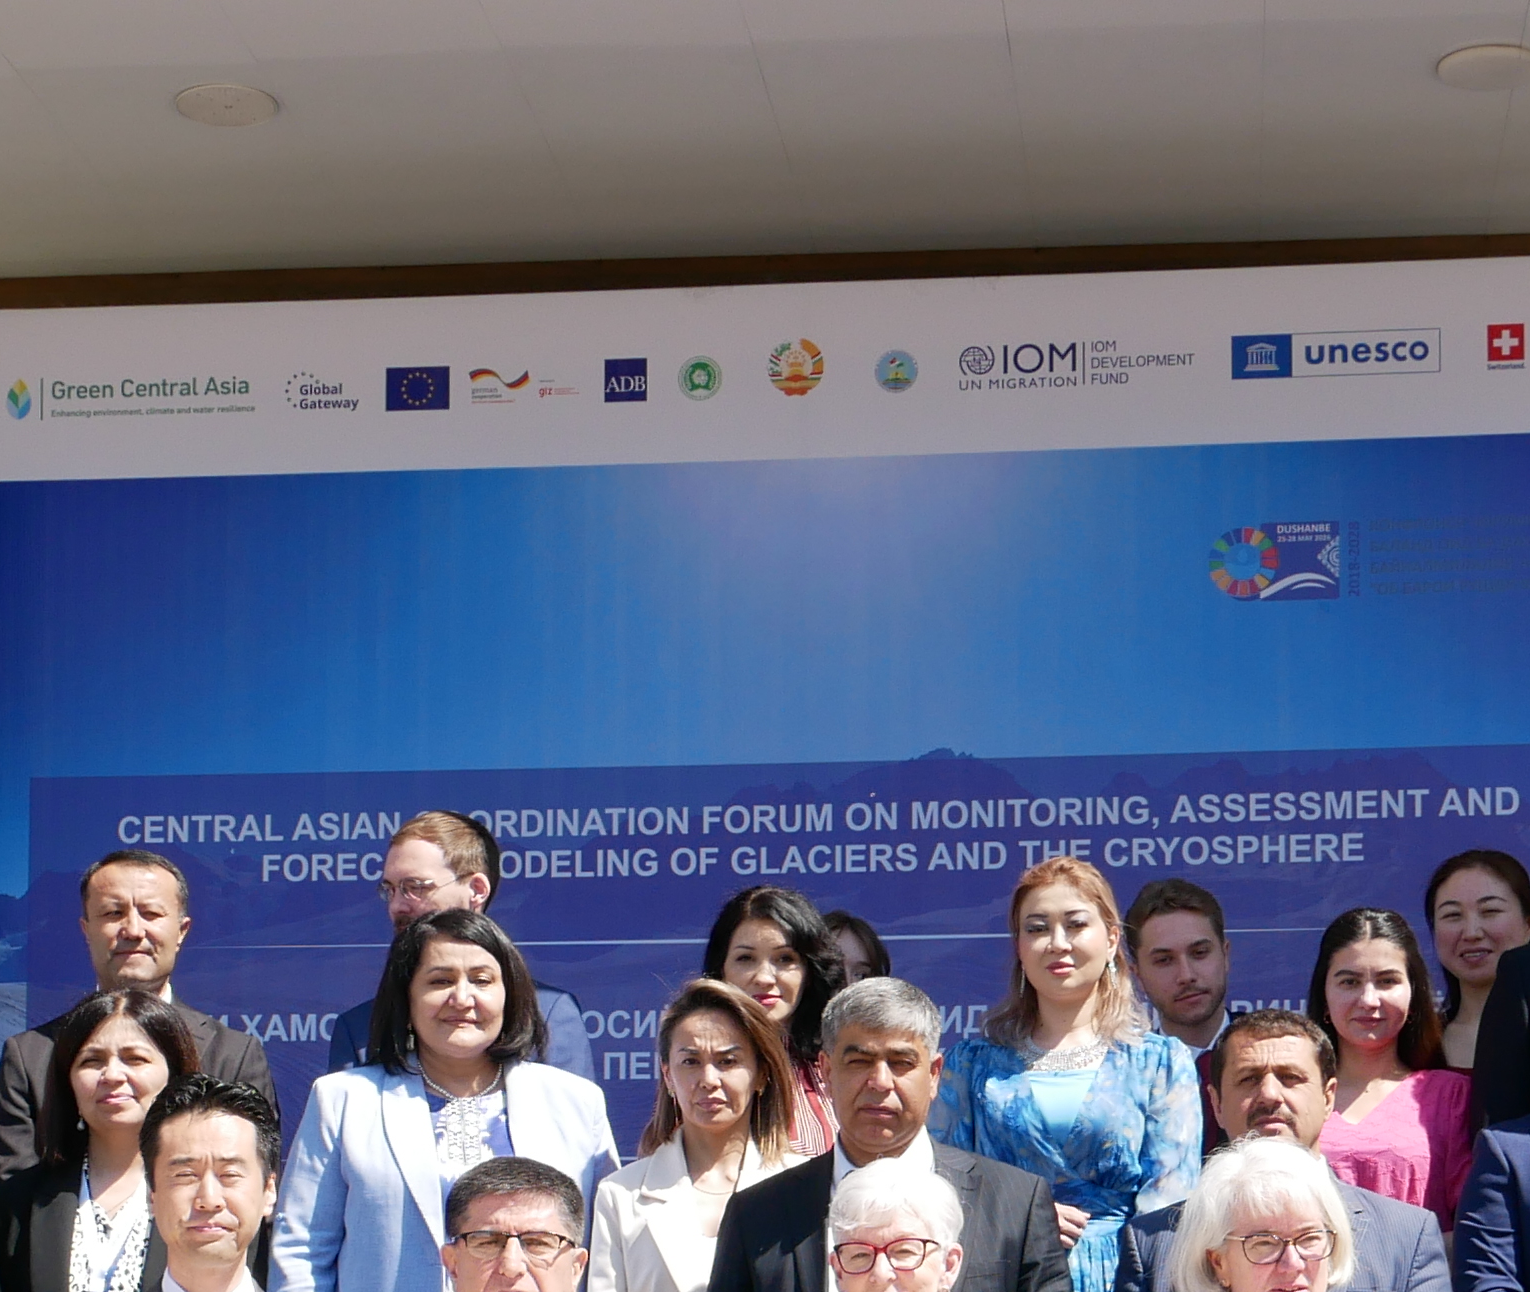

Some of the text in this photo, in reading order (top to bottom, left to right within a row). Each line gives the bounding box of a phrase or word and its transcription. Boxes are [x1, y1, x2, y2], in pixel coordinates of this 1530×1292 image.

[1090, 340, 1117, 353] IOM
[1304, 340, 1430, 365] unesco
[1002, 341, 1078, 375] IOM
[1090, 353, 1195, 369] DEVELOPMENT
[605, 375, 646, 393] ADB
[959, 376, 1078, 391] UN MIGRATION
[1090, 372, 1130, 386] FUND
[51, 376, 250, 400] Green Central Asia
[299, 382, 343, 396] Global
[50, 404, 256, 419] Enhancing environment, climate and water resilience
[299, 398, 359, 412] Gateway
[1276, 523, 1331, 534] DUSHANBE
[118, 814, 284, 844] CENTRAL
[291, 811, 401, 841] ASIAN
[702, 803, 833, 834] FORUM
[845, 801, 898, 832] ON
[911, 795, 1160, 831] MONITORING,
[1169, 788, 1431, 824] ASSESSMENT
[1438, 786, 1521, 817] AND
[499, 848, 659, 879] ODELING
[670, 847, 719, 876] OF
[731, 842, 918, 875] GLACIERS
[927, 841, 1007, 871] AND
[1104, 832, 1365, 867] CRYOSPHERE
